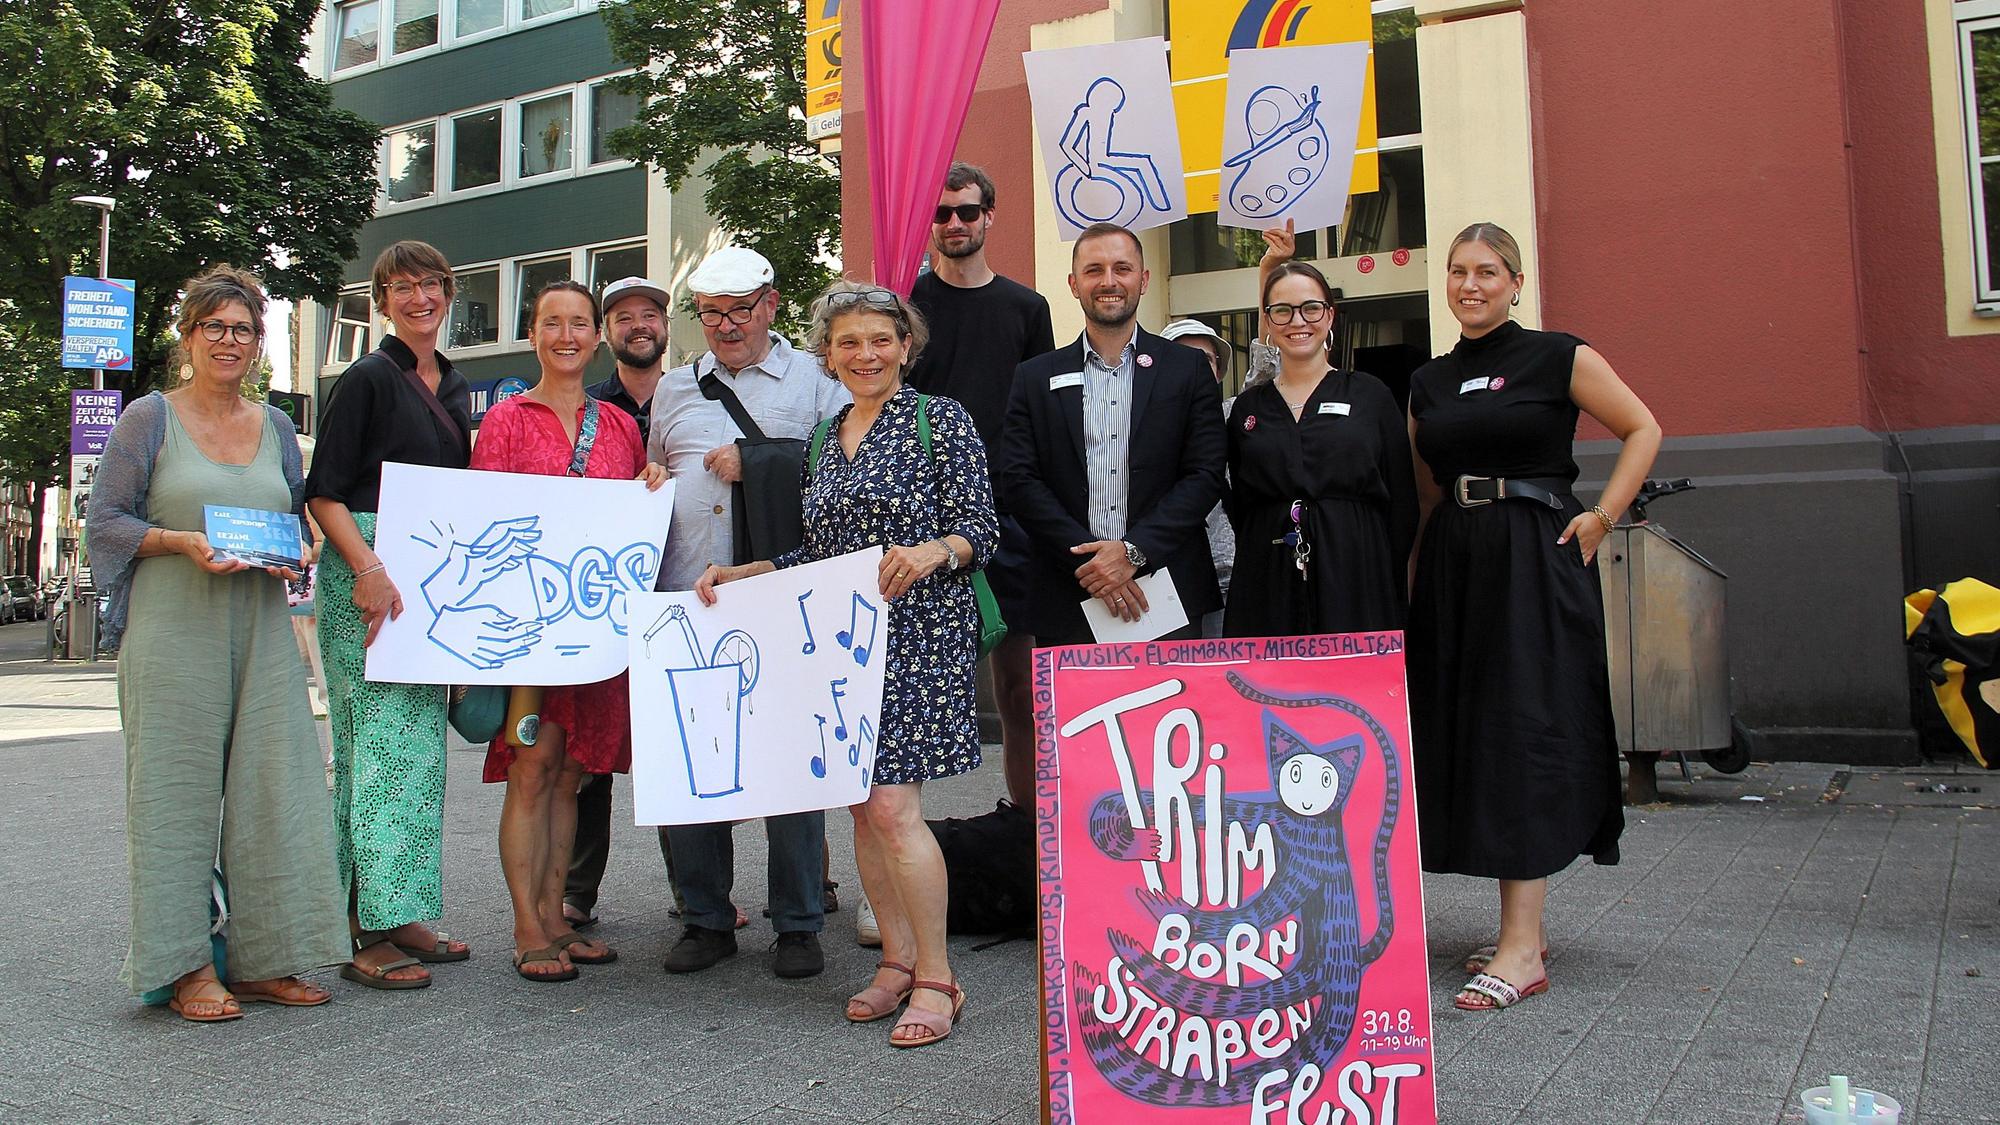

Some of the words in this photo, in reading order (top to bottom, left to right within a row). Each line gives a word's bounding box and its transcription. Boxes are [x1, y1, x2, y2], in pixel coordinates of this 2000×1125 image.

[821, 116, 841, 130] Geld
[68, 290, 114, 303] FREIHEIT.
[67, 303, 130, 317] WOHLSTAND.
[67, 316, 127, 330] SICHERHEIT.
[67, 336, 117, 345] VERSPRECHEN
[66, 344, 96, 353] HALTEN.
[96, 347, 124, 360] AfD
[76, 395, 117, 407] KEINE
[76, 407, 96, 415] ZEIT
[98, 406, 116, 416] FÜR
[75, 415, 116, 425] FAXEN
[88, 442, 103, 450] Volt
[525, 541, 661, 636] DGS
[1058, 644, 1140, 670] MUSIK.
[1360, 1035, 1400, 1051] 11-19
